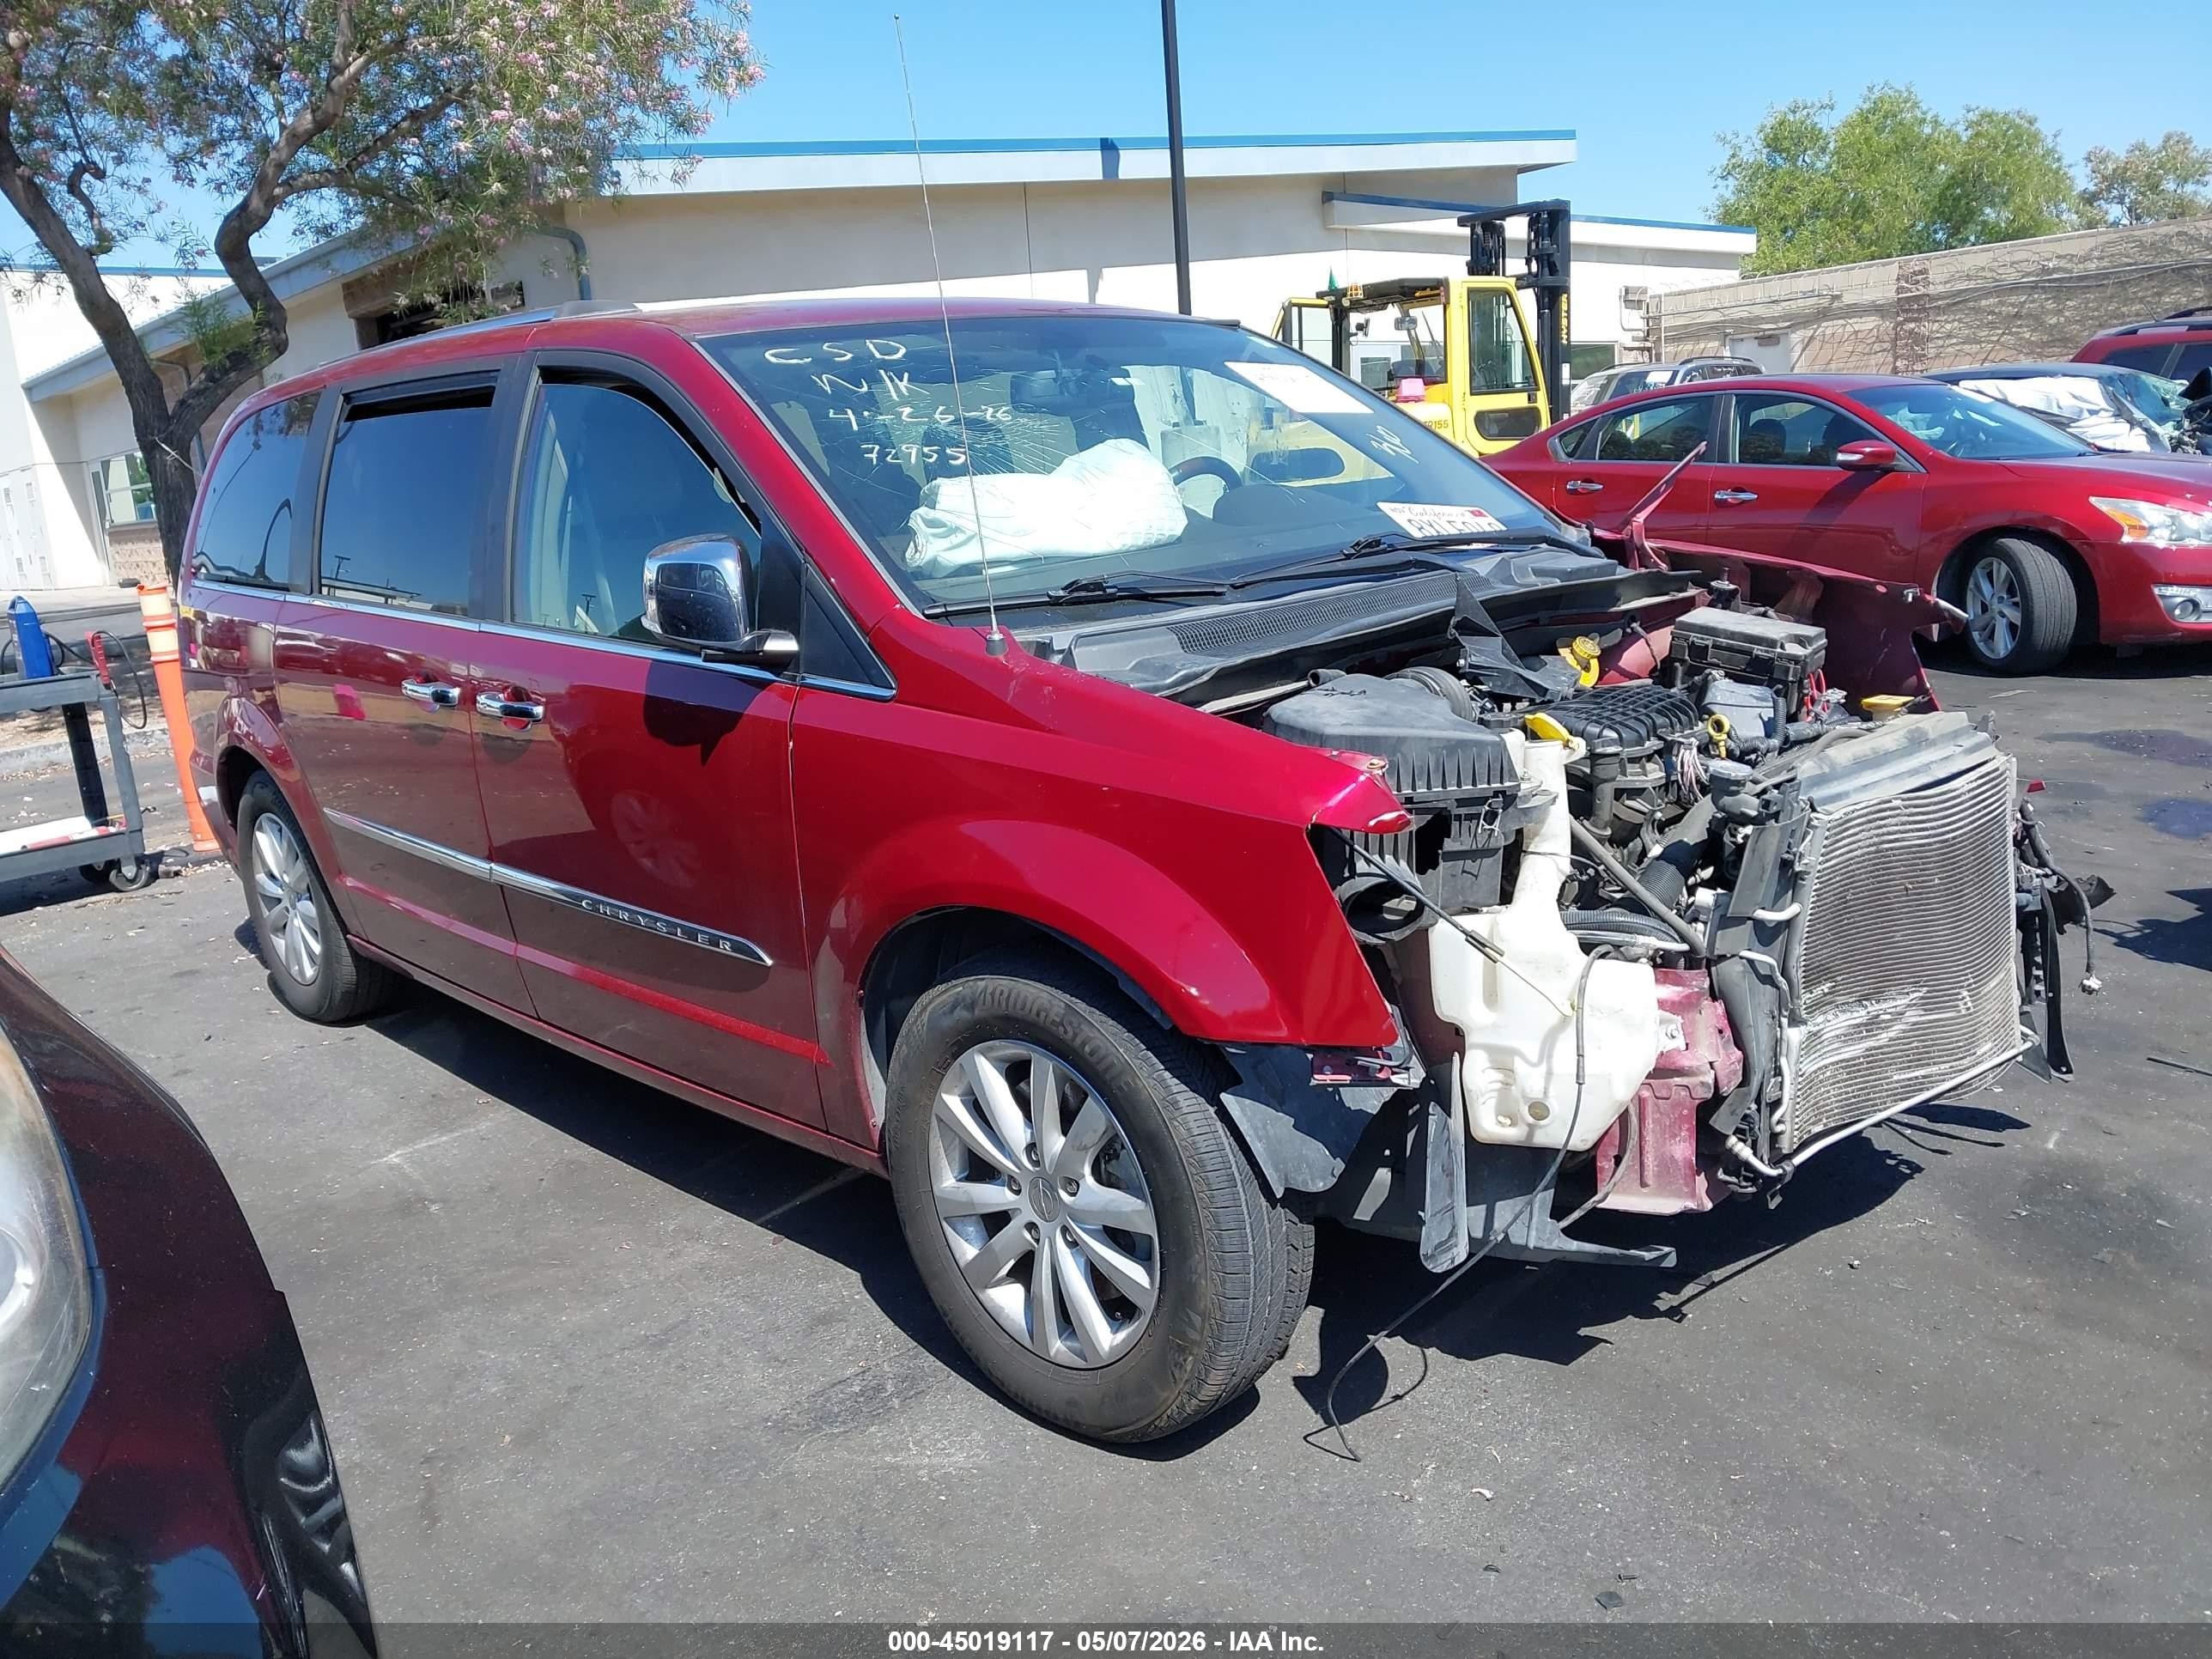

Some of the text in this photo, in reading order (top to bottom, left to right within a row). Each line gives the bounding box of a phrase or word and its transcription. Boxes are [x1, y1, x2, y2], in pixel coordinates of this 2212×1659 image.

[1560, 293, 1569, 343] HYSTER
[764, 339, 907, 365] CSD
[860, 444, 967, 466] 72955
[581, 899, 732, 951] CHRYSLER
[976, 983, 1136, 1093] BRIDGESTONE
